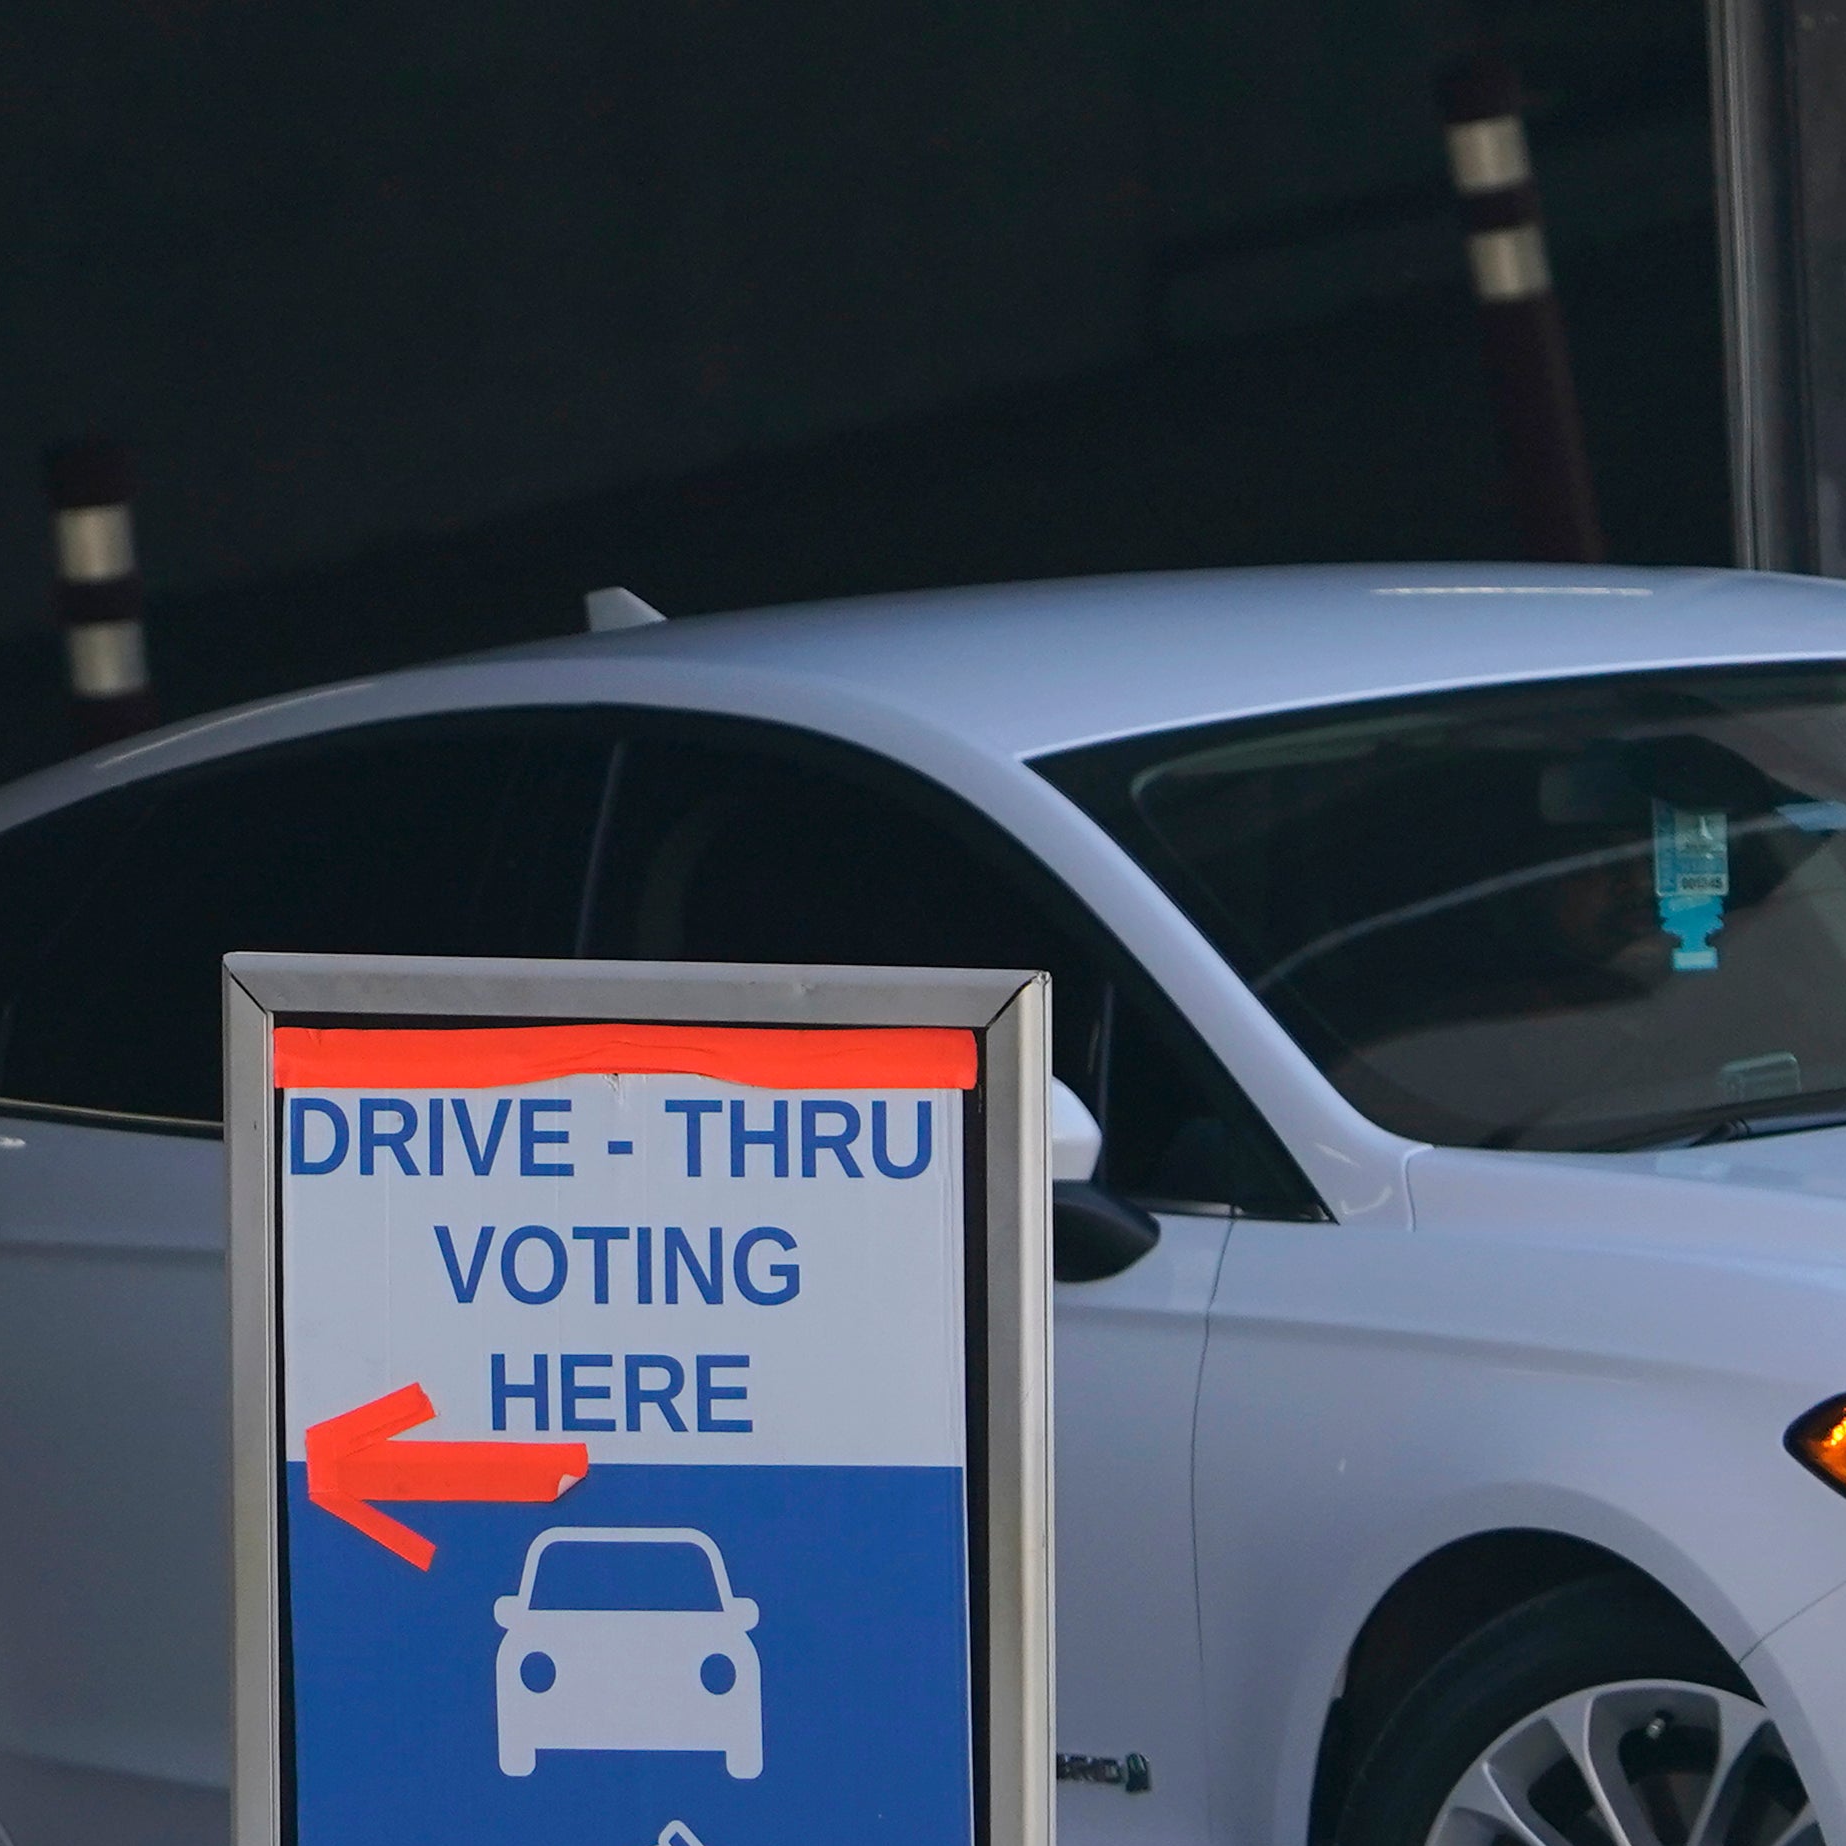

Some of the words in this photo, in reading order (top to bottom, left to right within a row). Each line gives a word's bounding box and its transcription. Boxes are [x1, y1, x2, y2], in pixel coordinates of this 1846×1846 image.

[290, 1098, 575, 1177] DRIVE
[665, 1100, 934, 1181] THRU
[434, 1225, 802, 1307] VOTING
[491, 1353, 754, 1434] HERE
